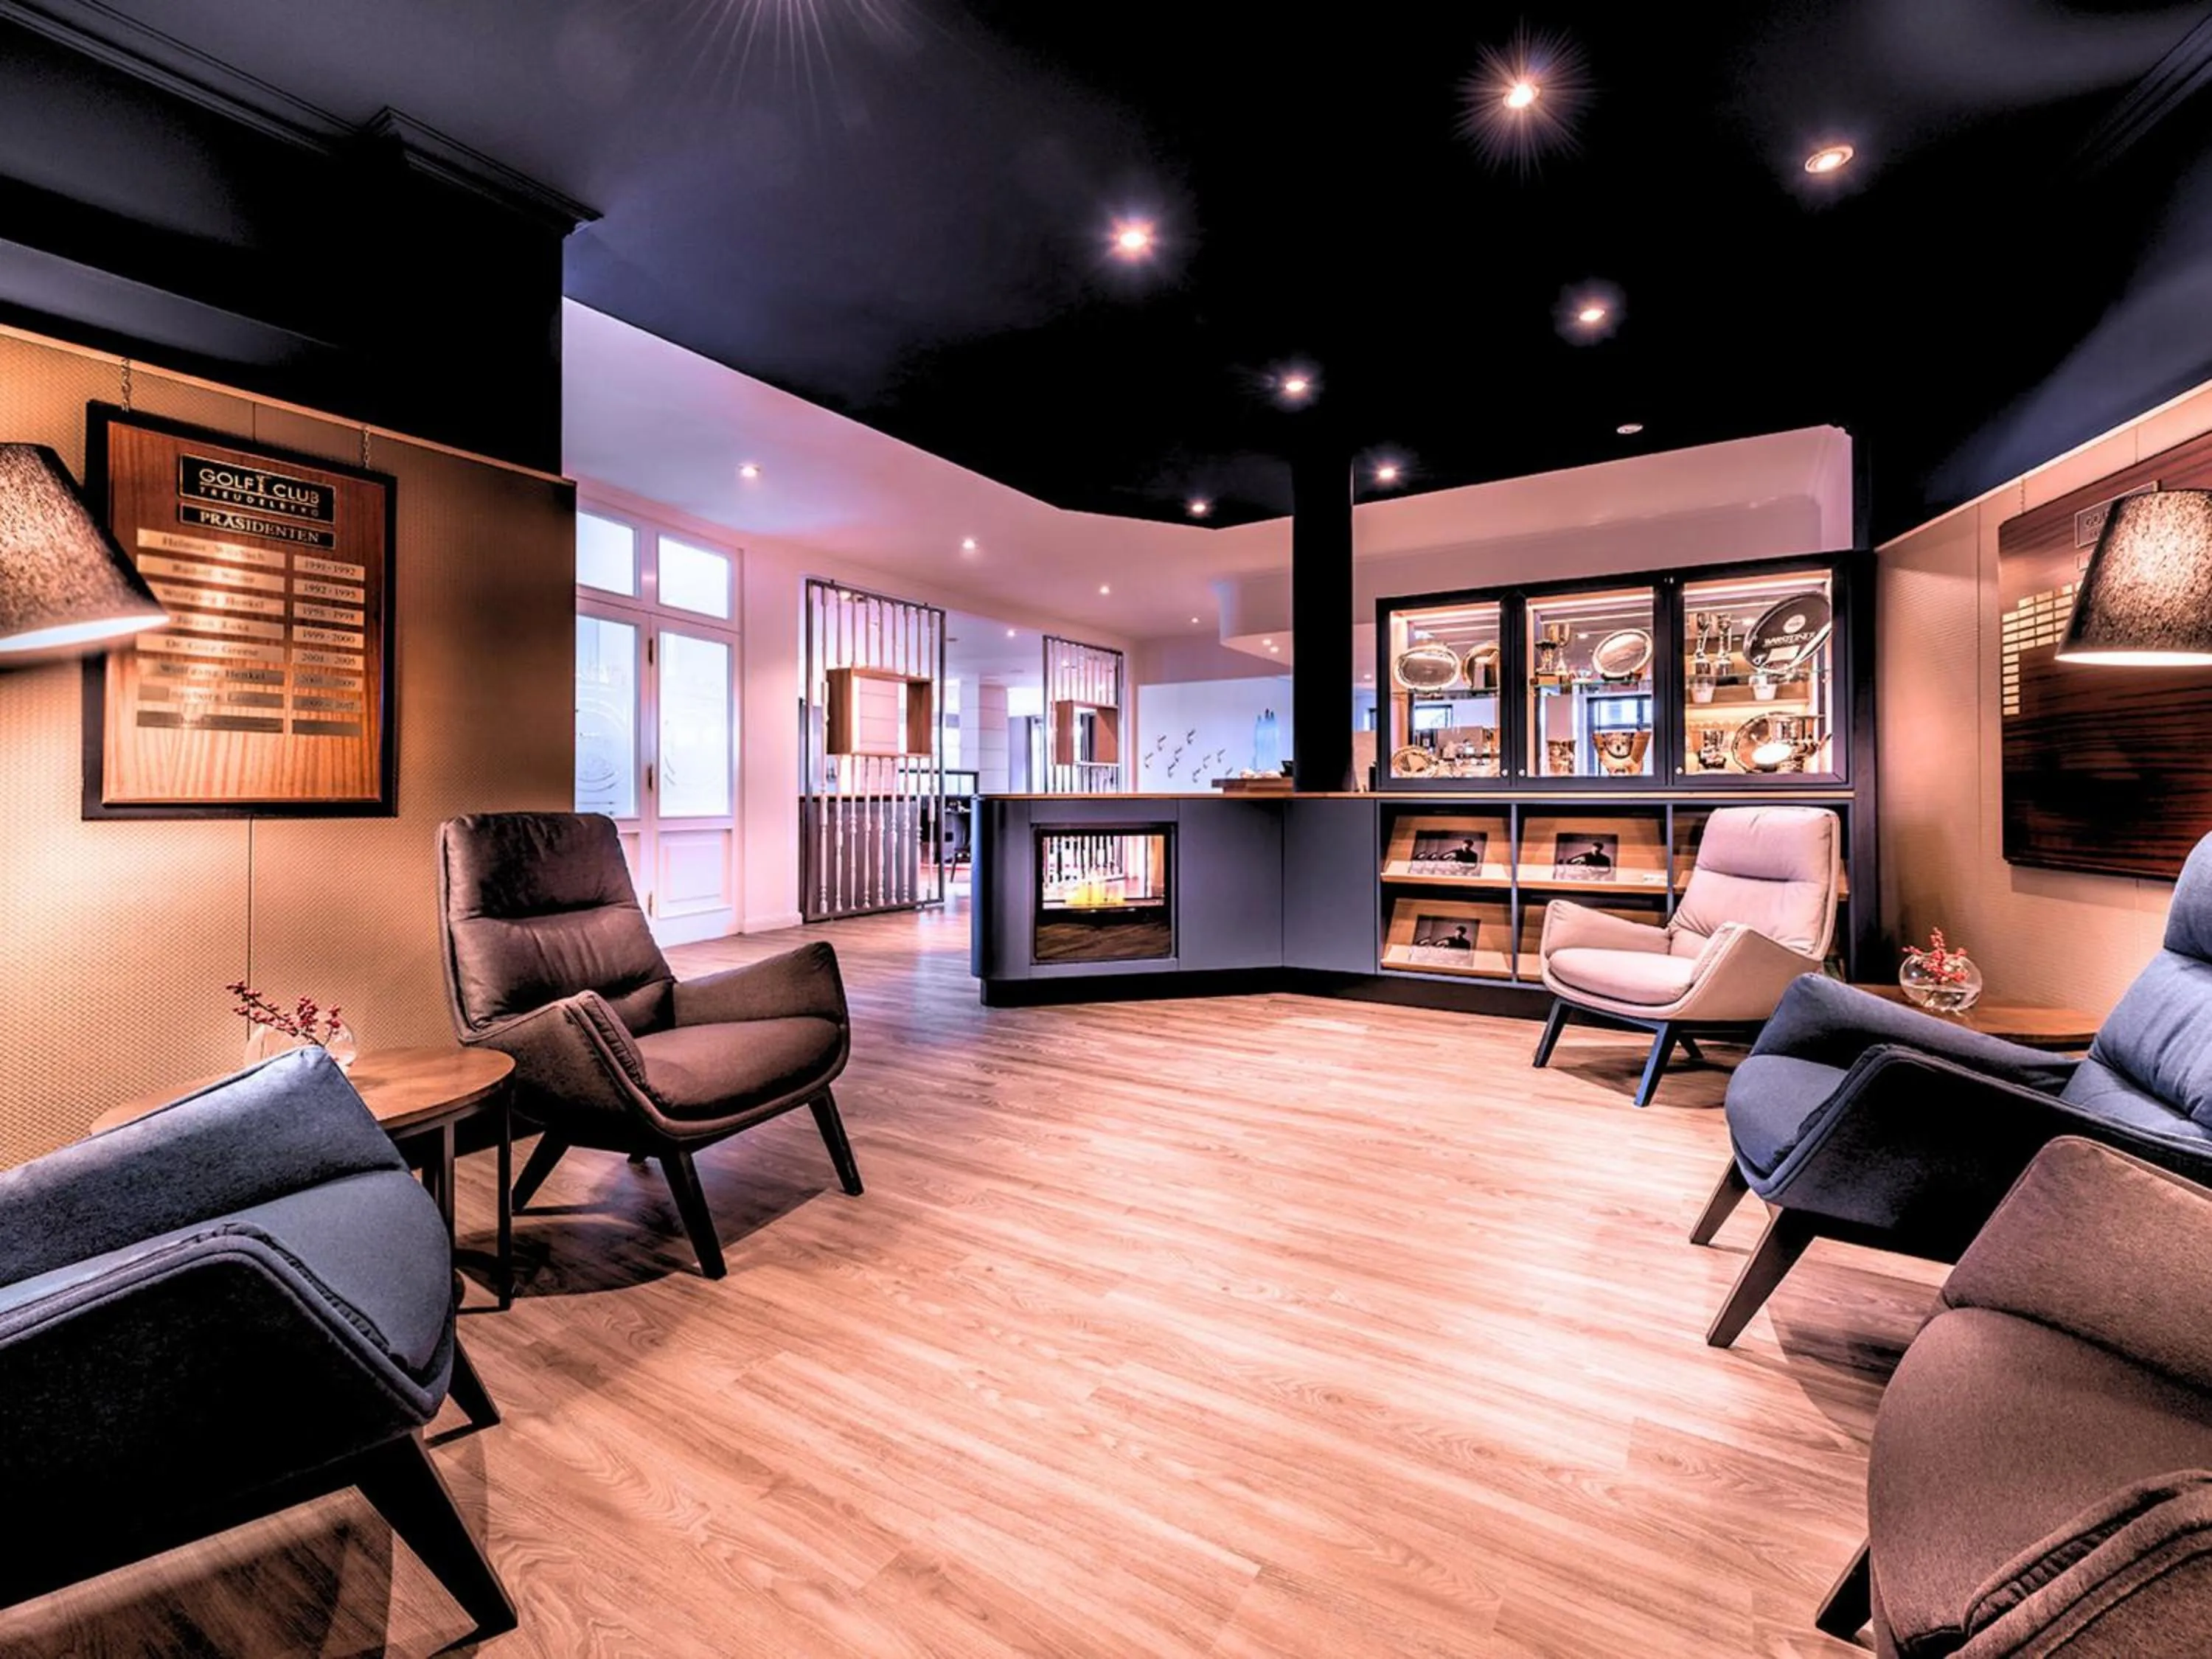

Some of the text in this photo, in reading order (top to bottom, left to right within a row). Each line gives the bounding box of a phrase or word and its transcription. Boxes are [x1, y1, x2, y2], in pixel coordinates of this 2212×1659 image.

[199, 468, 319, 504] GOLF CLUB
[199, 486, 319, 517] TREUDELBERG
